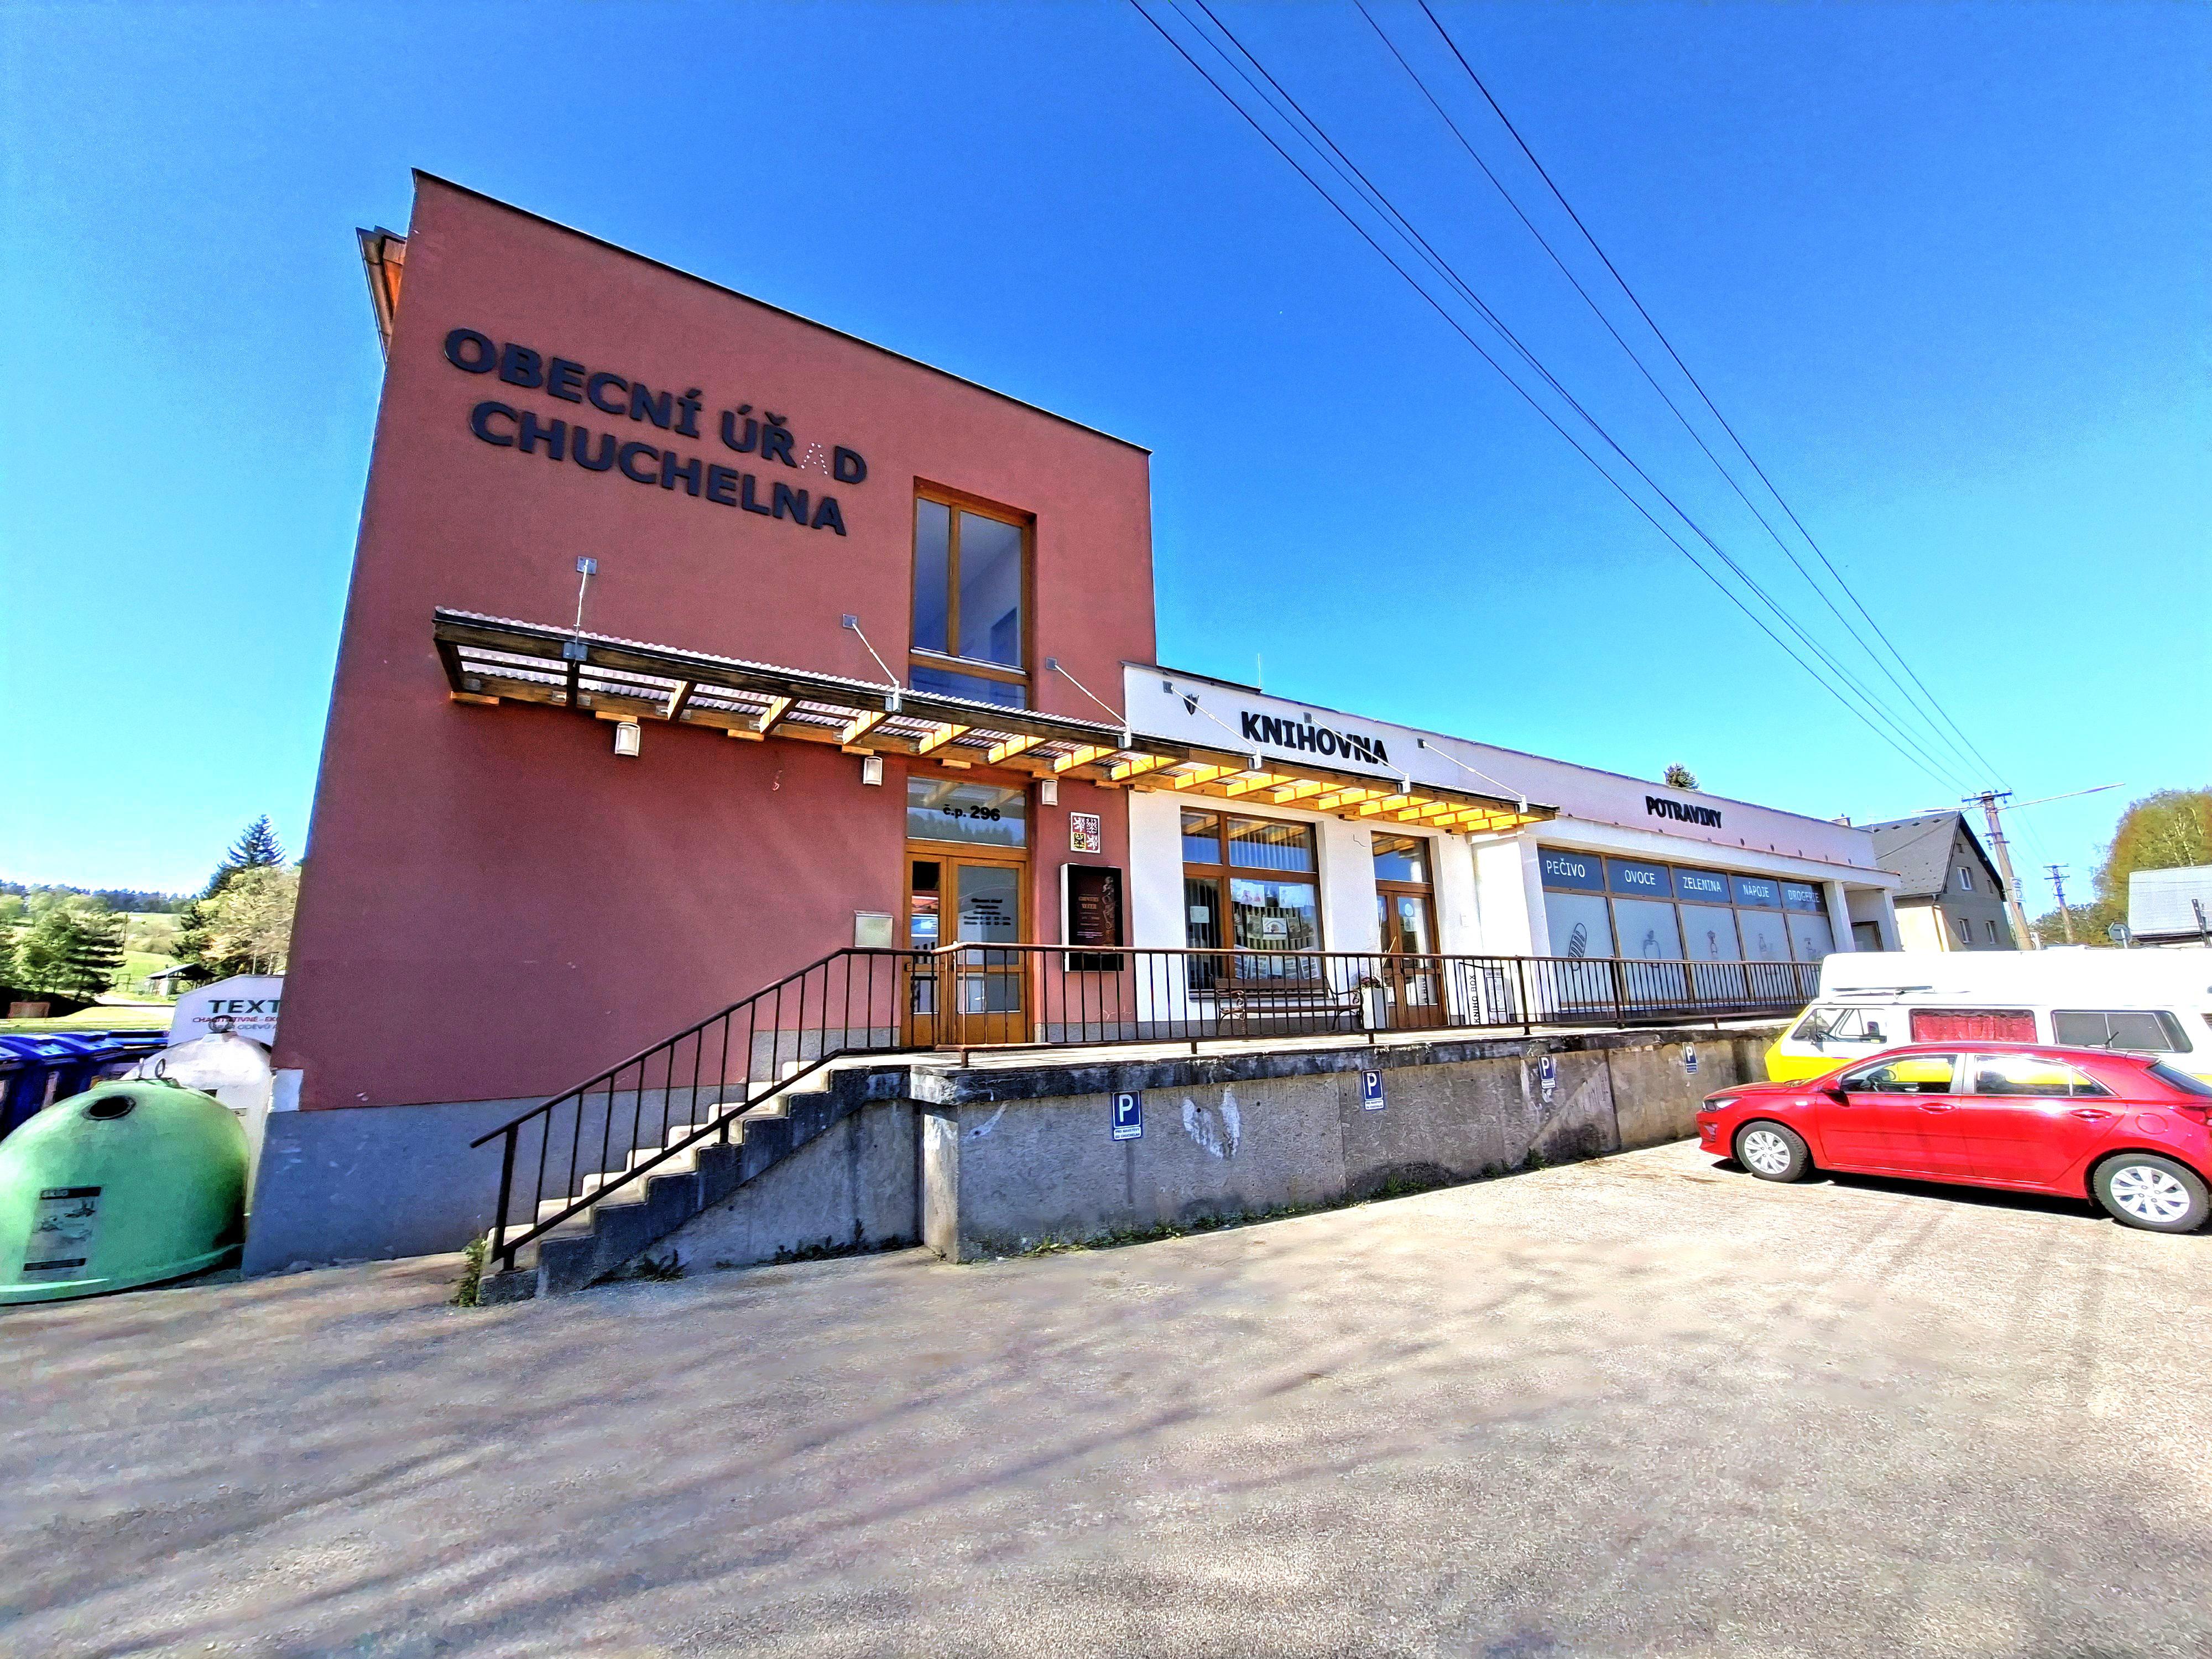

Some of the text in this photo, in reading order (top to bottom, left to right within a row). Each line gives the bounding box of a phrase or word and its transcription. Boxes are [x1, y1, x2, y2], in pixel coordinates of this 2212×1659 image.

[444, 327, 702, 439] OBECNÍ
[469, 400, 847, 536] CHUCHELNA
[1241, 711, 1389, 766] KNIHOVNA
[970, 805, 1000, 822] 296
[1645, 795, 1722, 829] POTRAVINY
[1546, 857, 1585, 878] PEČIVO
[1624, 870, 1656, 885] OVOCE
[1682, 877, 1722, 893] ZELENINA
[1743, 881, 1770, 898] NÁPOJE
[1787, 889, 1820, 903] DROGERIE
[1686, 1046, 1693, 1062] P
[1541, 1057, 1549, 1077] P
[1367, 1073, 1377, 1096] P
[1119, 1094, 1134, 1123] P
